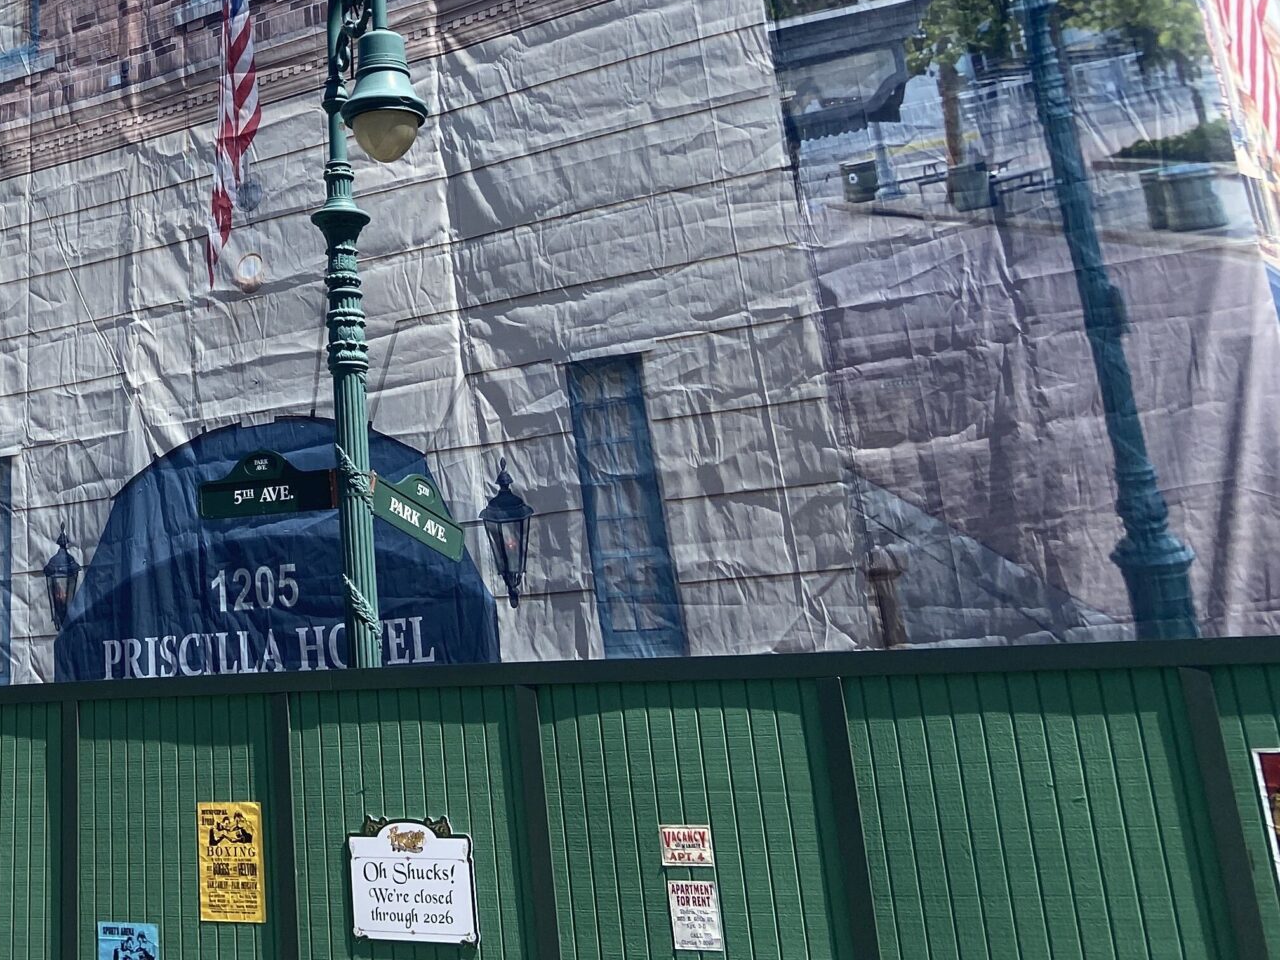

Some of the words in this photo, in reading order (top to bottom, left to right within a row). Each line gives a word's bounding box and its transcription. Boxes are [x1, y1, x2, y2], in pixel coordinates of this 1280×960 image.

[253, 458, 269, 466] PARK
[233, 488, 255, 505] 5TH
[259, 485, 294, 503] AVE.
[416, 483, 430, 497] 5TH
[388, 496, 422, 528] PARK
[422, 519, 447, 543] AVE.
[211, 563, 299, 612] 1205
[102, 628, 286, 680] PRISCILLA
[295, 616, 435, 671] HOEL
[663, 830, 706, 848] VACANCY
[207, 846, 256, 858] BOXING
[669, 852, 695, 862] APT.
[697, 852, 705, 862] 4
[362, 861, 387, 883] Oh
[392, 861, 455, 885] Shucks!
[369, 887, 410, 904] We're
[414, 889, 454, 905] closed
[671, 884, 714, 896] APARTMENT
[676, 895, 691, 907] FOR
[692, 896, 711, 908] RENT
[371, 907, 418, 929] through
[423, 910, 454, 924] 2026
